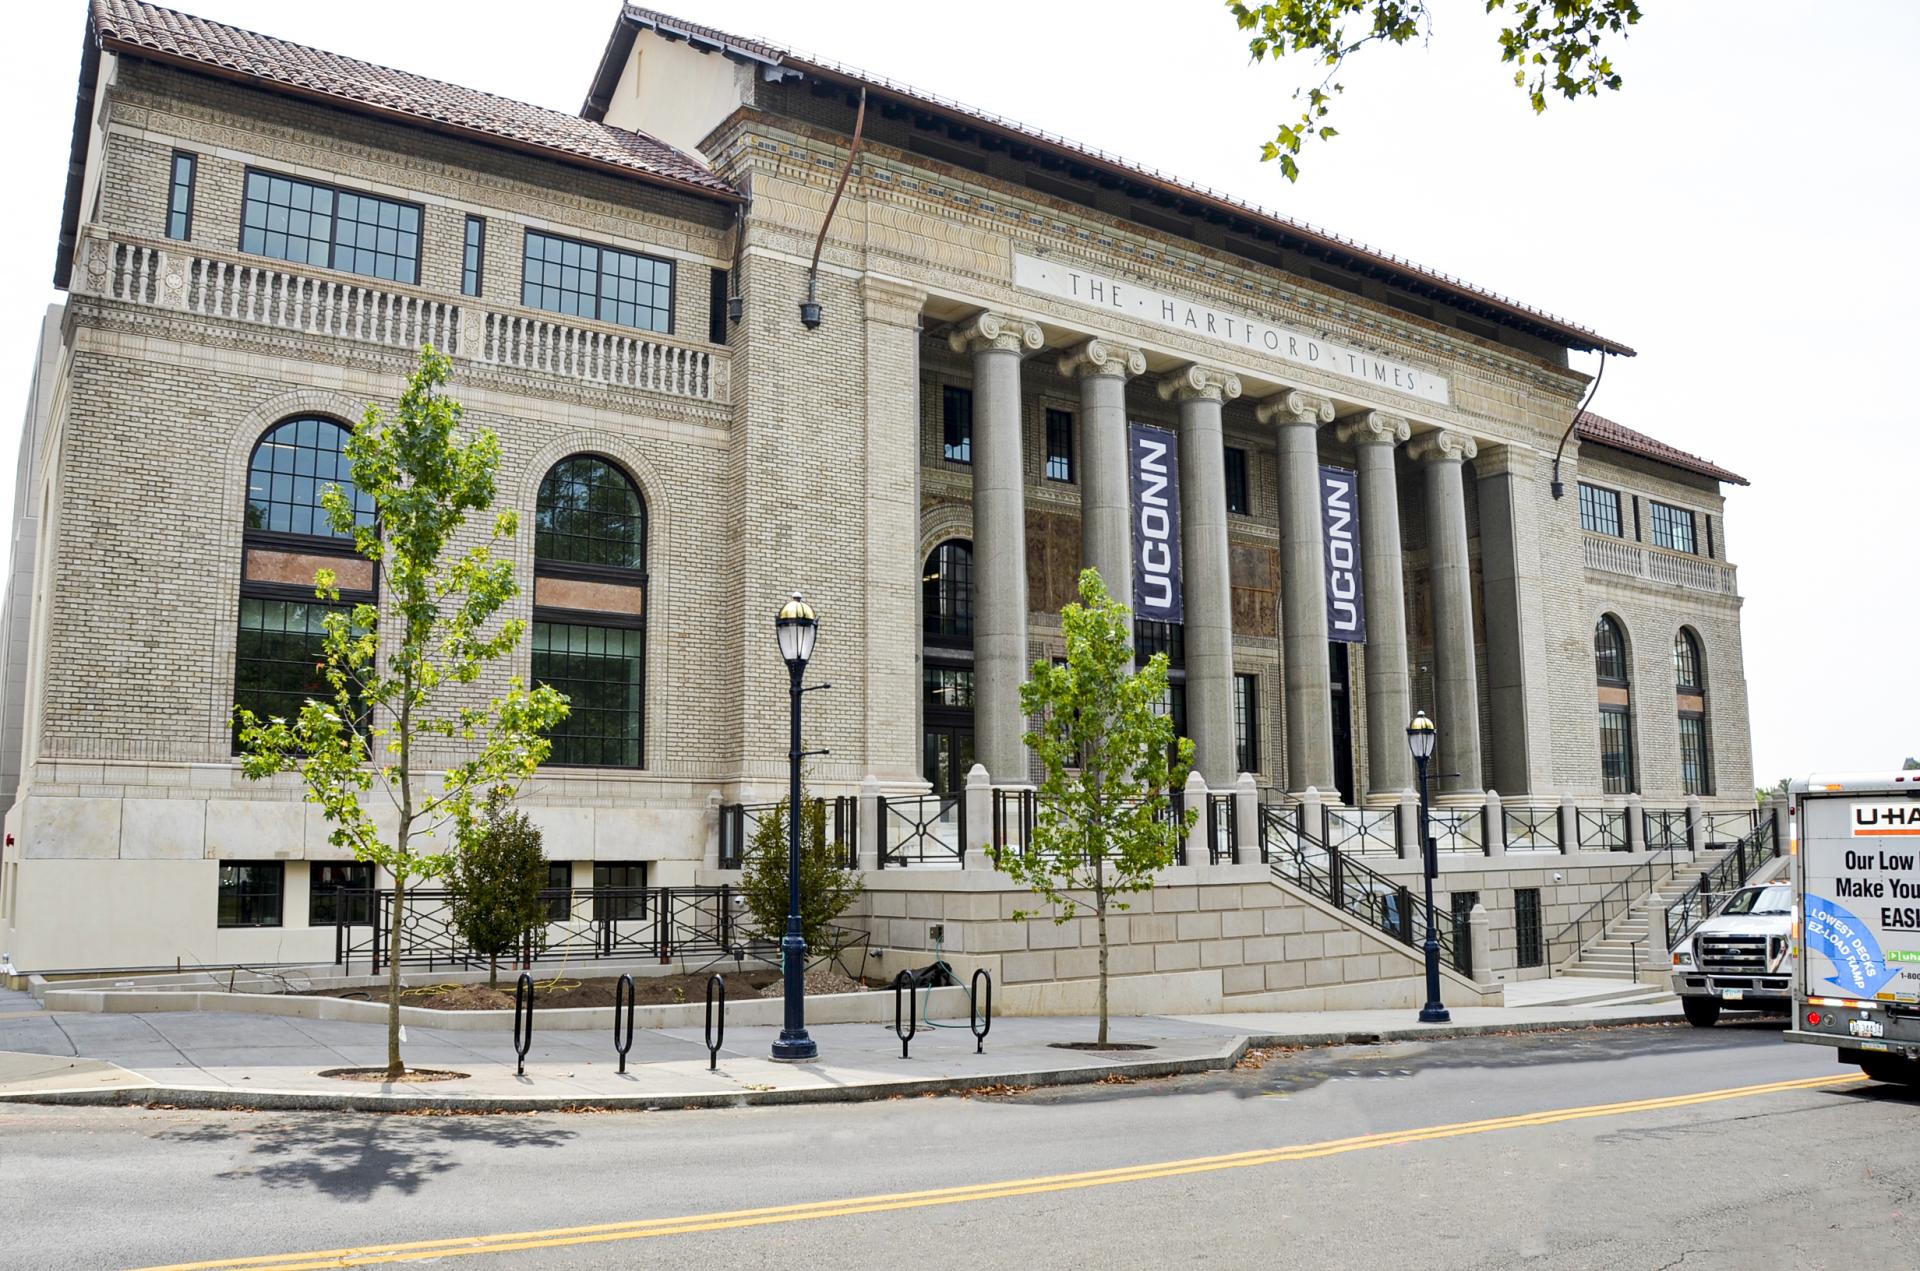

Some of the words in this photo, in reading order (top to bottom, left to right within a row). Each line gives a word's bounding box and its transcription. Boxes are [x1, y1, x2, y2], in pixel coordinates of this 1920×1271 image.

[1069, 273, 1123, 307] THE
[1162, 299, 1319, 361] HARTFORD
[1347, 353, 1415, 390] TIMES
[1139, 439, 1173, 608] UCONN
[1326, 479, 1357, 631] UCONN
[1836, 878, 1884, 898] Make
[1889, 879, 1920, 899] You
[1845, 850, 1874, 870] Our
[1879, 851, 1914, 871] Low
[1808, 920, 1851, 955] EZ-LOAD
[1846, 955, 1865, 989] RAMP
[1811, 908, 1855, 938] LOWEST
[1852, 938, 1876, 977] DECKS
